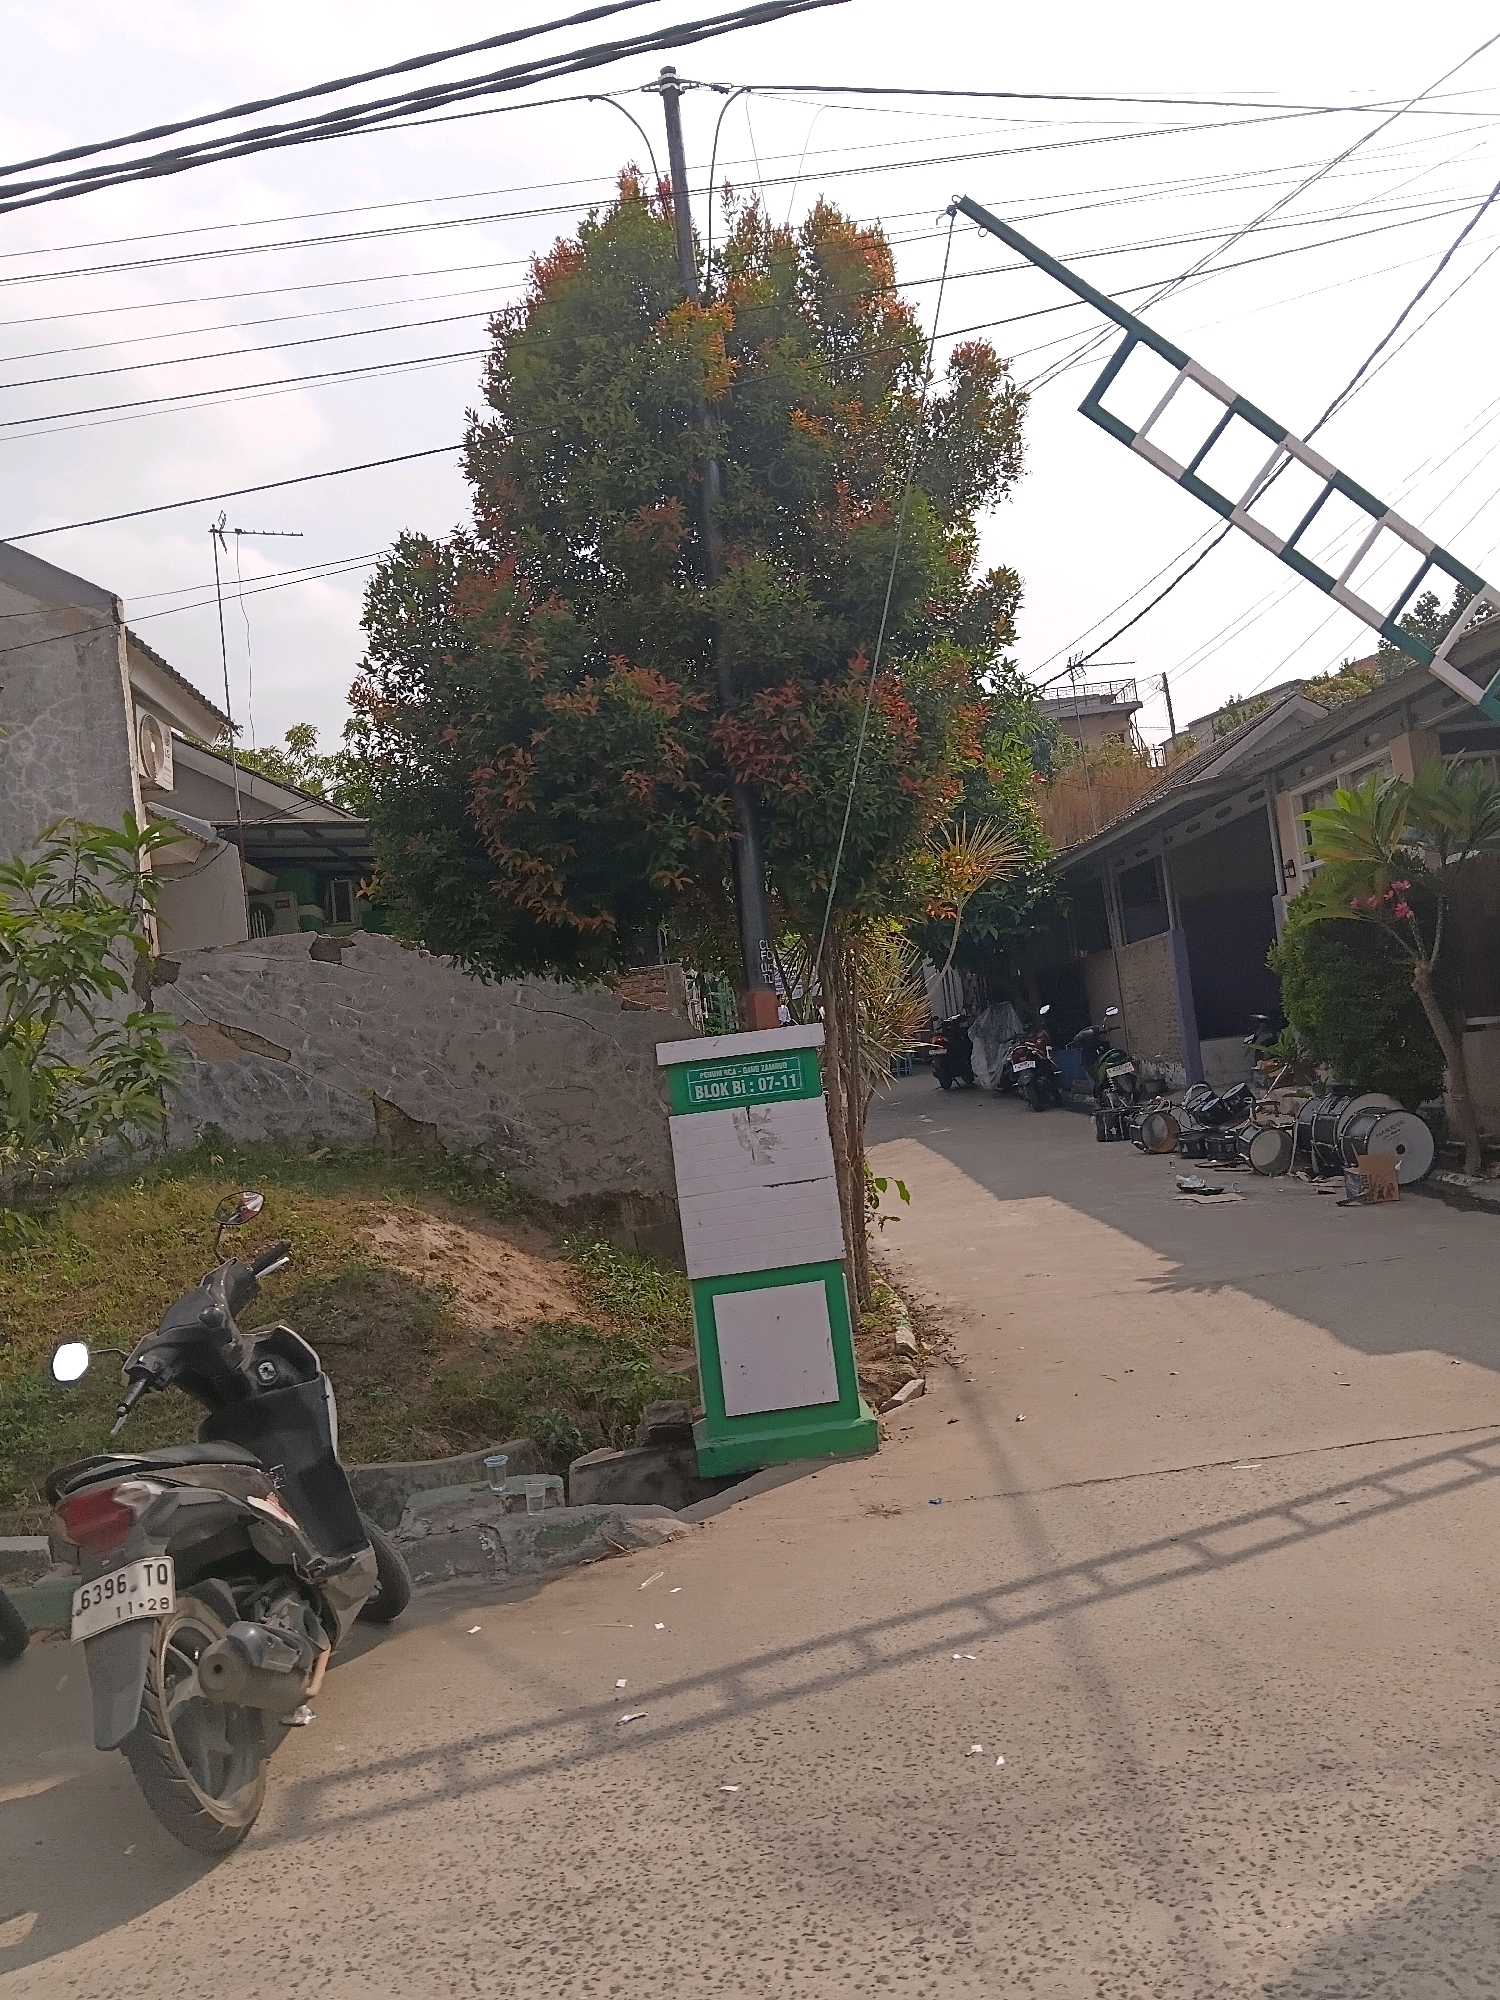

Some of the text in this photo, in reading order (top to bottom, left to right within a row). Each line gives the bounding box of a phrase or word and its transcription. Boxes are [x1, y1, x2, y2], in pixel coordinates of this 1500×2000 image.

[695, 1083, 730, 1100] BLOK
[758, 1074, 797, 1091] 07-11
[80, 1573, 127, 1610] 6396
